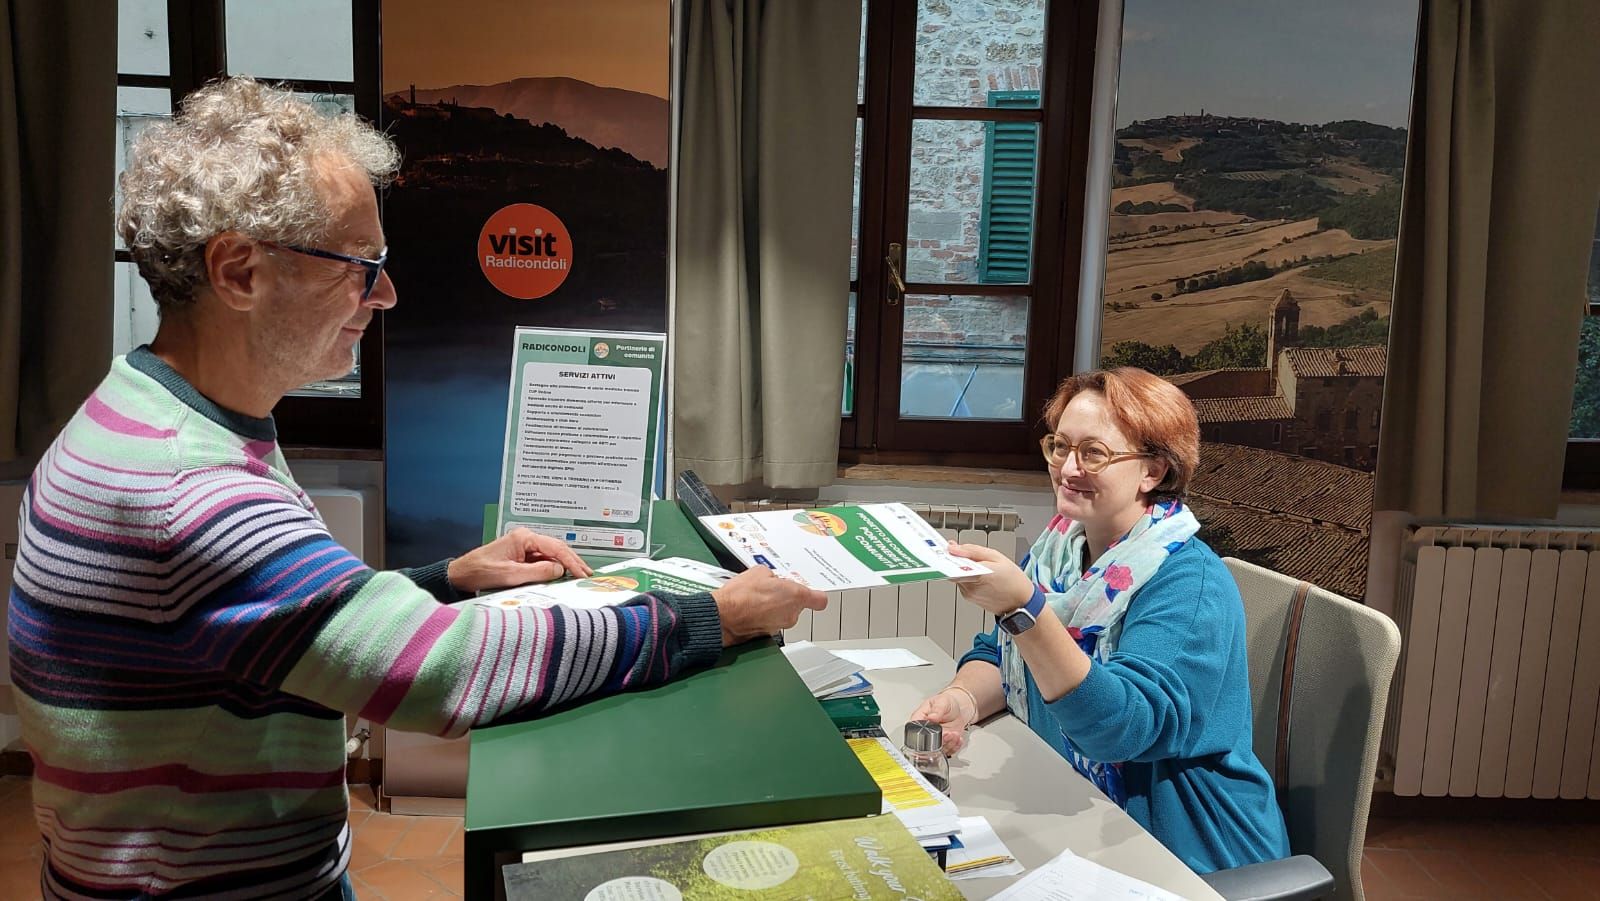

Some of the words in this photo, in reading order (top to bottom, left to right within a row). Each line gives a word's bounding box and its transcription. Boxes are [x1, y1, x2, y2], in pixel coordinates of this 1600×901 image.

[488, 227, 557, 256] visit
[485, 255, 567, 270] Radicondoli
[522, 342, 586, 353] RADICONDOLI
[558, 371, 590, 379] SERVIZI
[855, 536, 899, 568] COMUNITÀ
[856, 512, 887, 539] PROGETTO
[888, 542, 924, 568] COMUNITÀ
[859, 526, 903, 562] PORTINERIE
[854, 836, 894, 868] Walk
[868, 869, 906, 894] your
